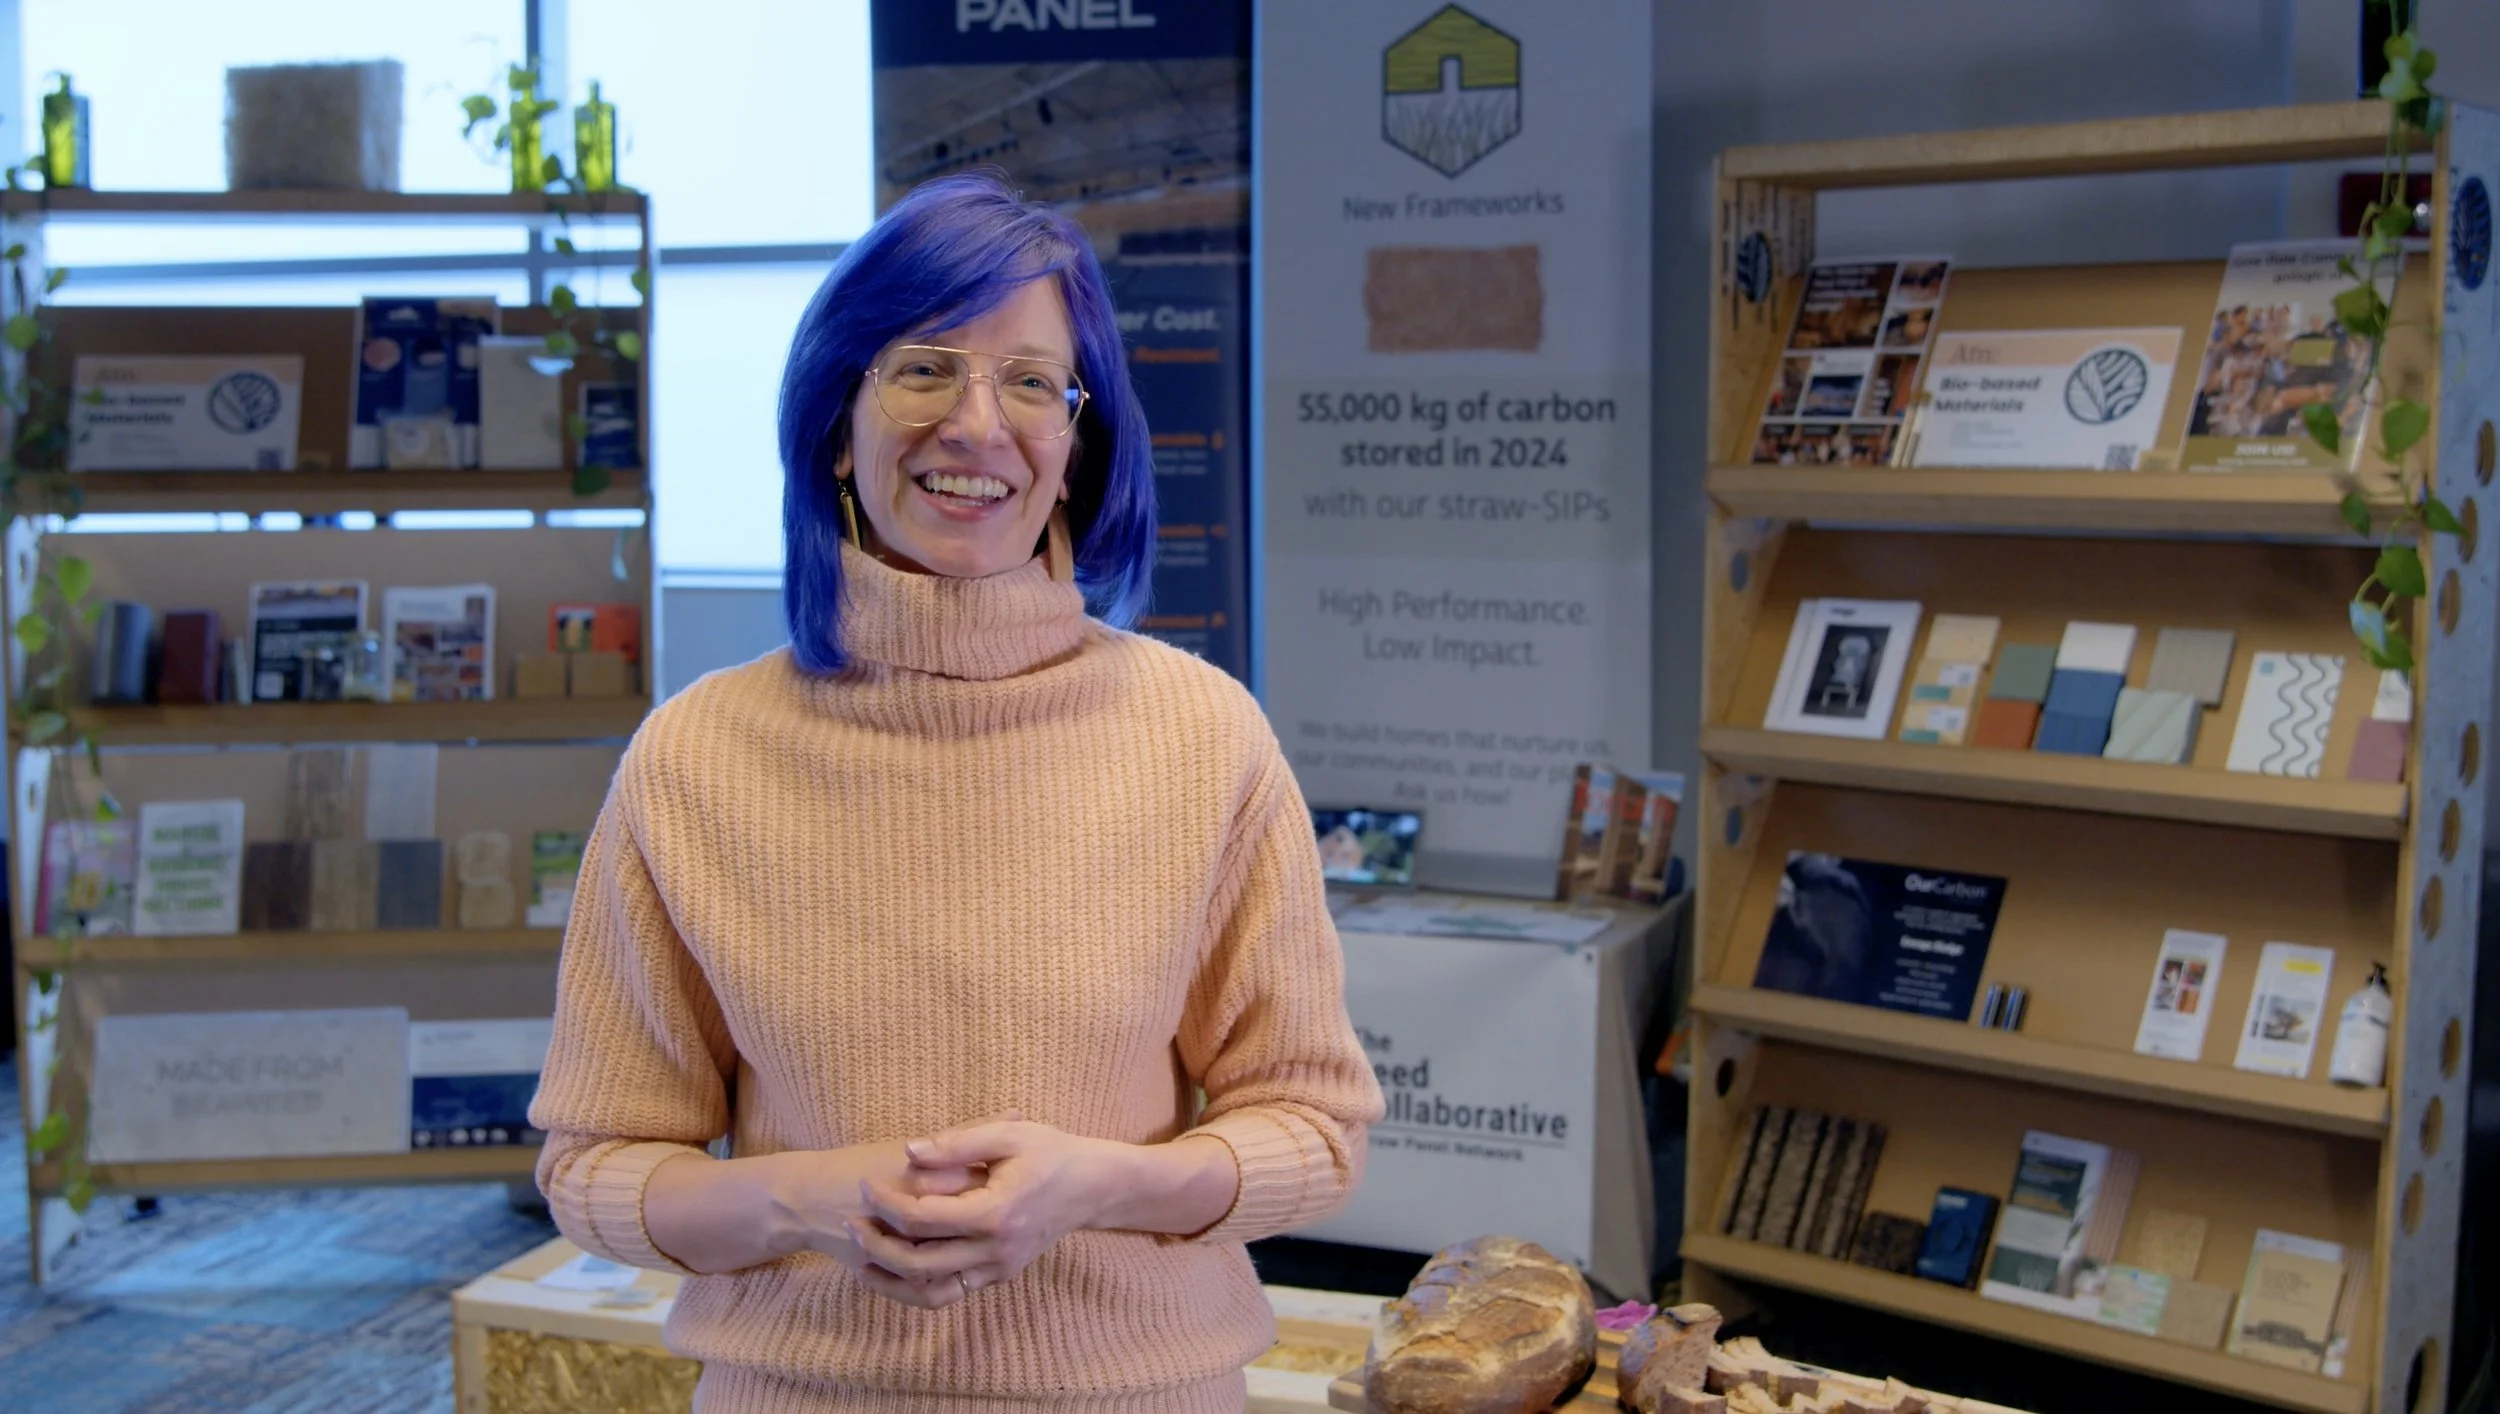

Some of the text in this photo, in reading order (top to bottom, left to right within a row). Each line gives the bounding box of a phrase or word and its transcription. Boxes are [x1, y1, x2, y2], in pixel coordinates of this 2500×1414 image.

[957, 0, 1156, 31] PANEL
[1342, 190, 1565, 221] New Frameworks
[1298, 390, 1617, 431] 55,000 kg of carbon
[1341, 437, 1568, 468] stored in 2024
[1304, 487, 1611, 523] with our straw-SIPs
[1318, 588, 1590, 626] High Performance.
[1363, 632, 1542, 670] Low Impact.
[156, 1053, 343, 1085] MADE FROM
[1374, 1057, 1429, 1088] eed
